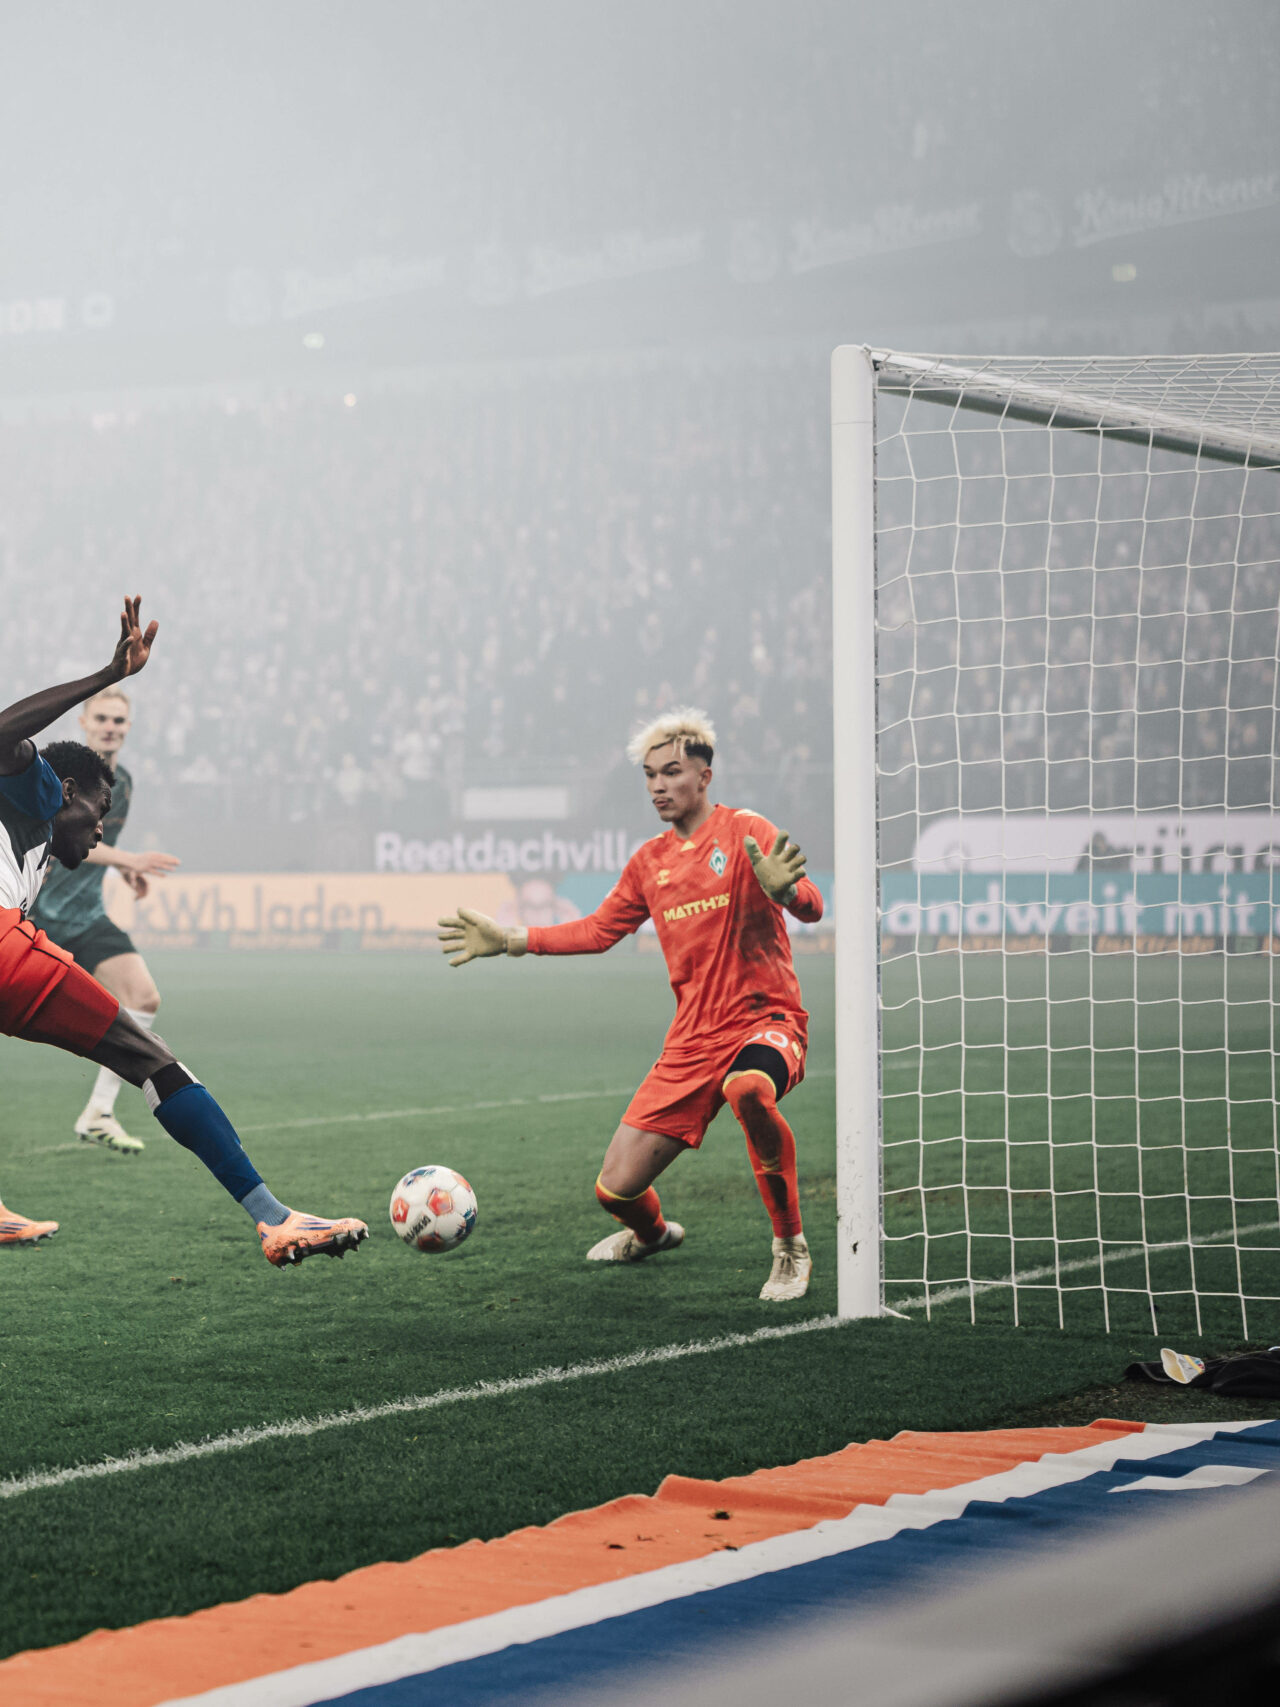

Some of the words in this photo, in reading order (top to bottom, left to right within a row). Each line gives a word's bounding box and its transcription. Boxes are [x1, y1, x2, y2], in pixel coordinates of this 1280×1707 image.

[663, 893, 730, 922] MATTHÄ
[883, 882, 1142, 935] andweit
[1164, 886, 1257, 935] mit
